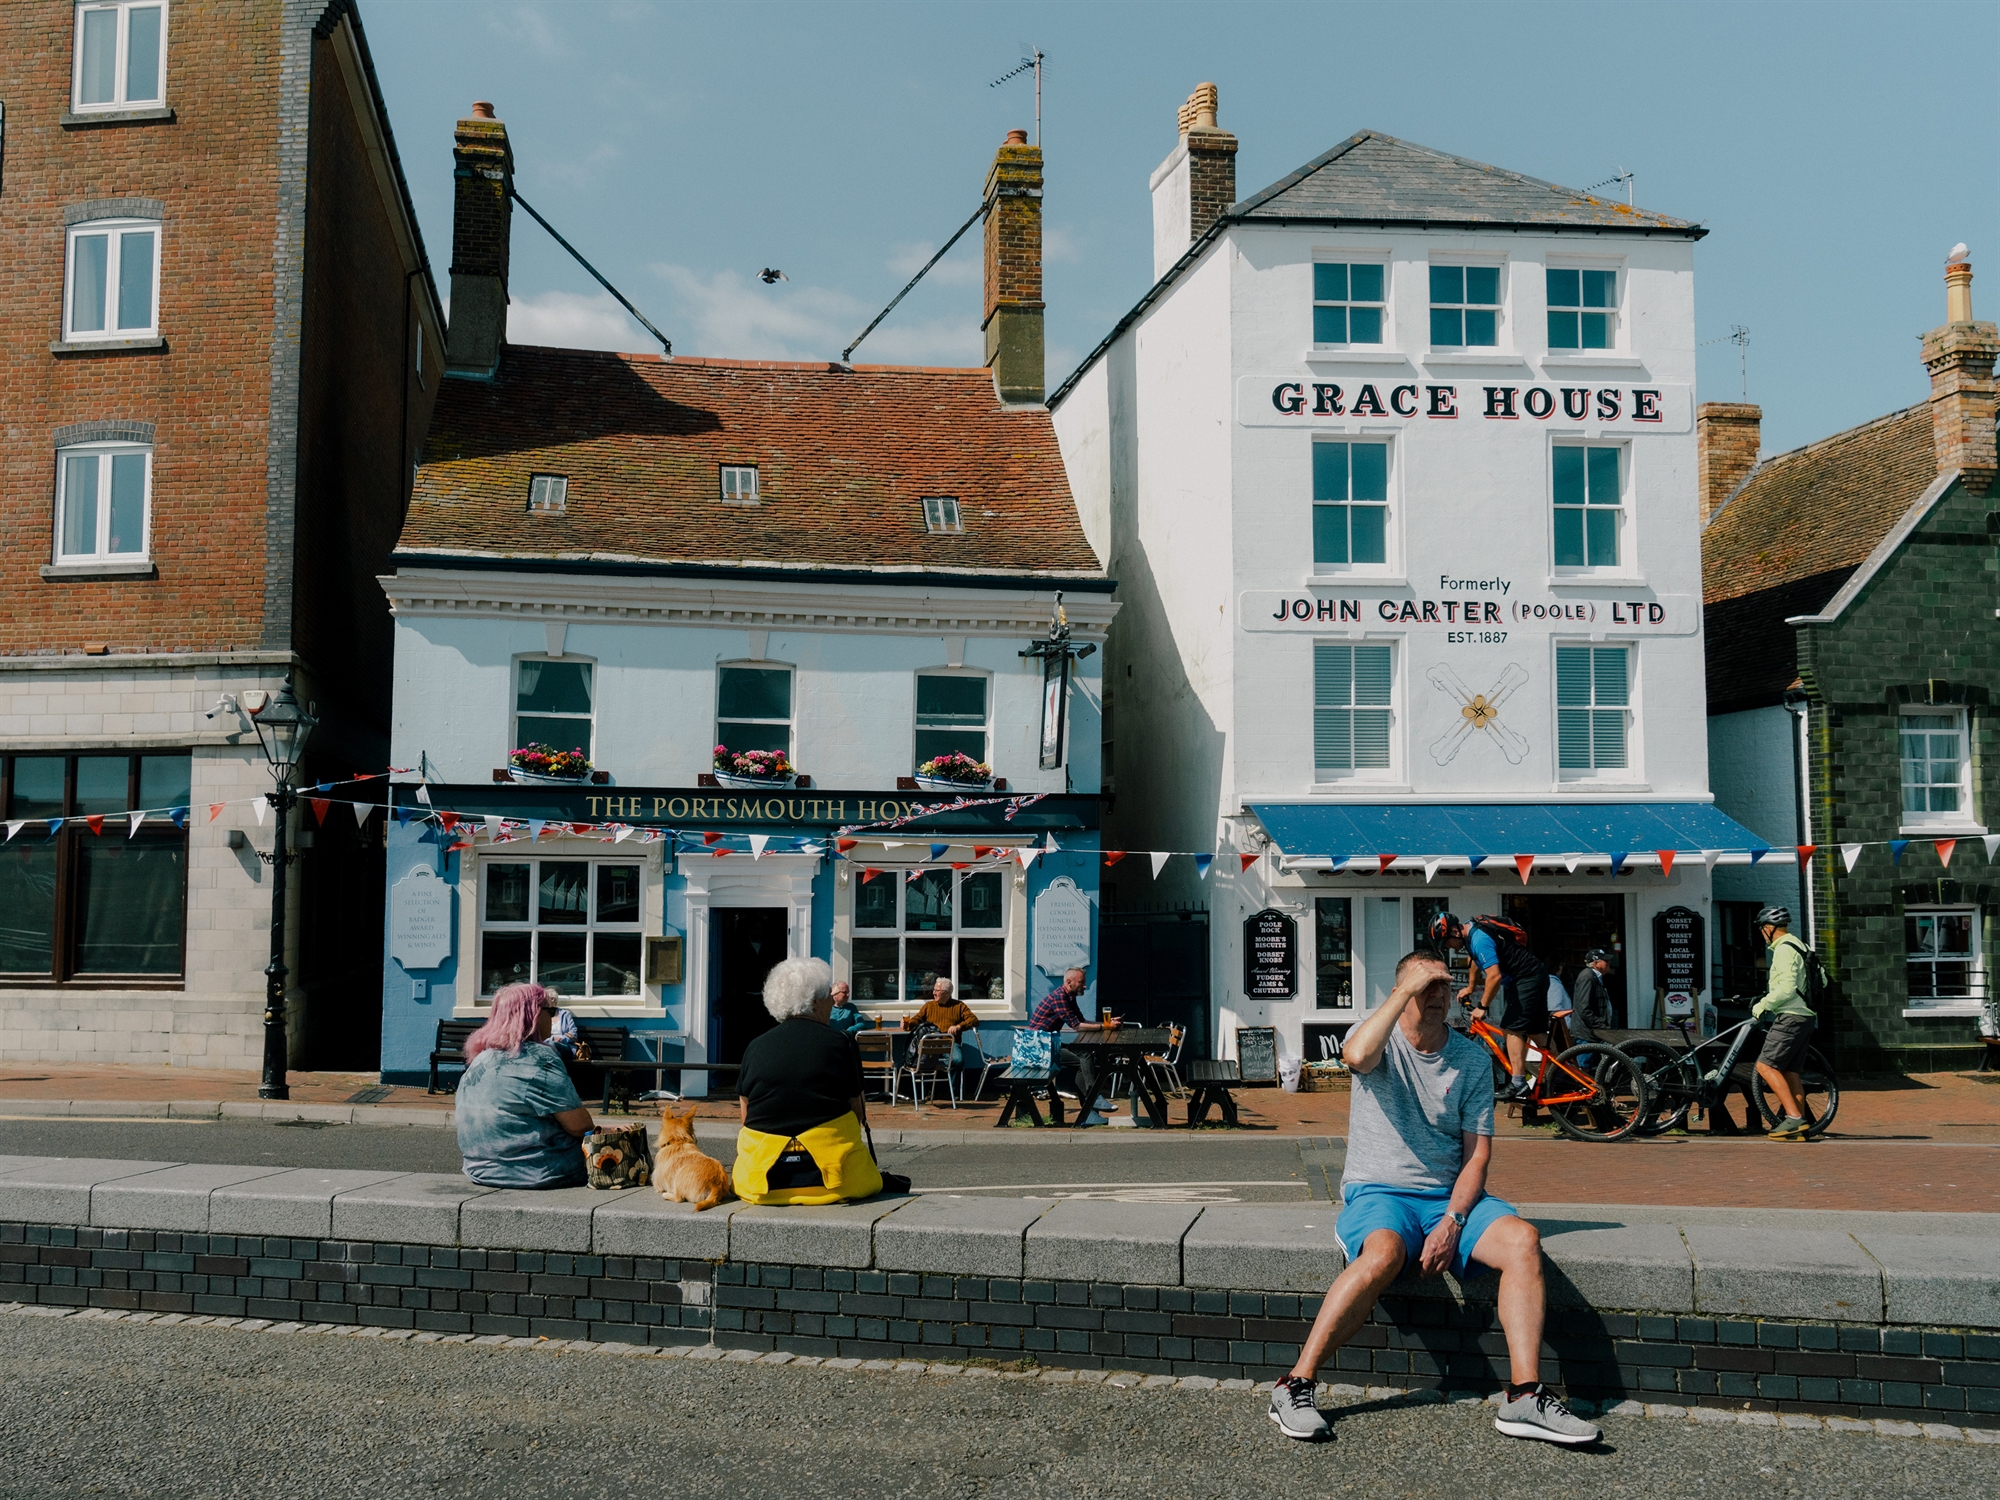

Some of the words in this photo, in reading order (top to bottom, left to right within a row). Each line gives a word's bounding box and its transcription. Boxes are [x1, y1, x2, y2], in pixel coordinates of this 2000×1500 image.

[1271, 382, 1459, 420] GRACE
[1482, 386, 1663, 423] HOUSE
[1440, 575, 1511, 595] Formerly
[1272, 598, 1361, 623] JOHN
[1377, 599, 1504, 624] CARTER
[1512, 602, 1596, 623] (POOLE)
[1611, 601, 1666, 625] LTD
[1447, 631, 1508, 644] EST.1887
[585, 796, 642, 818] THE
[652, 797, 846, 820] PORTSMOUTH
[857, 800, 917, 821] HOY
